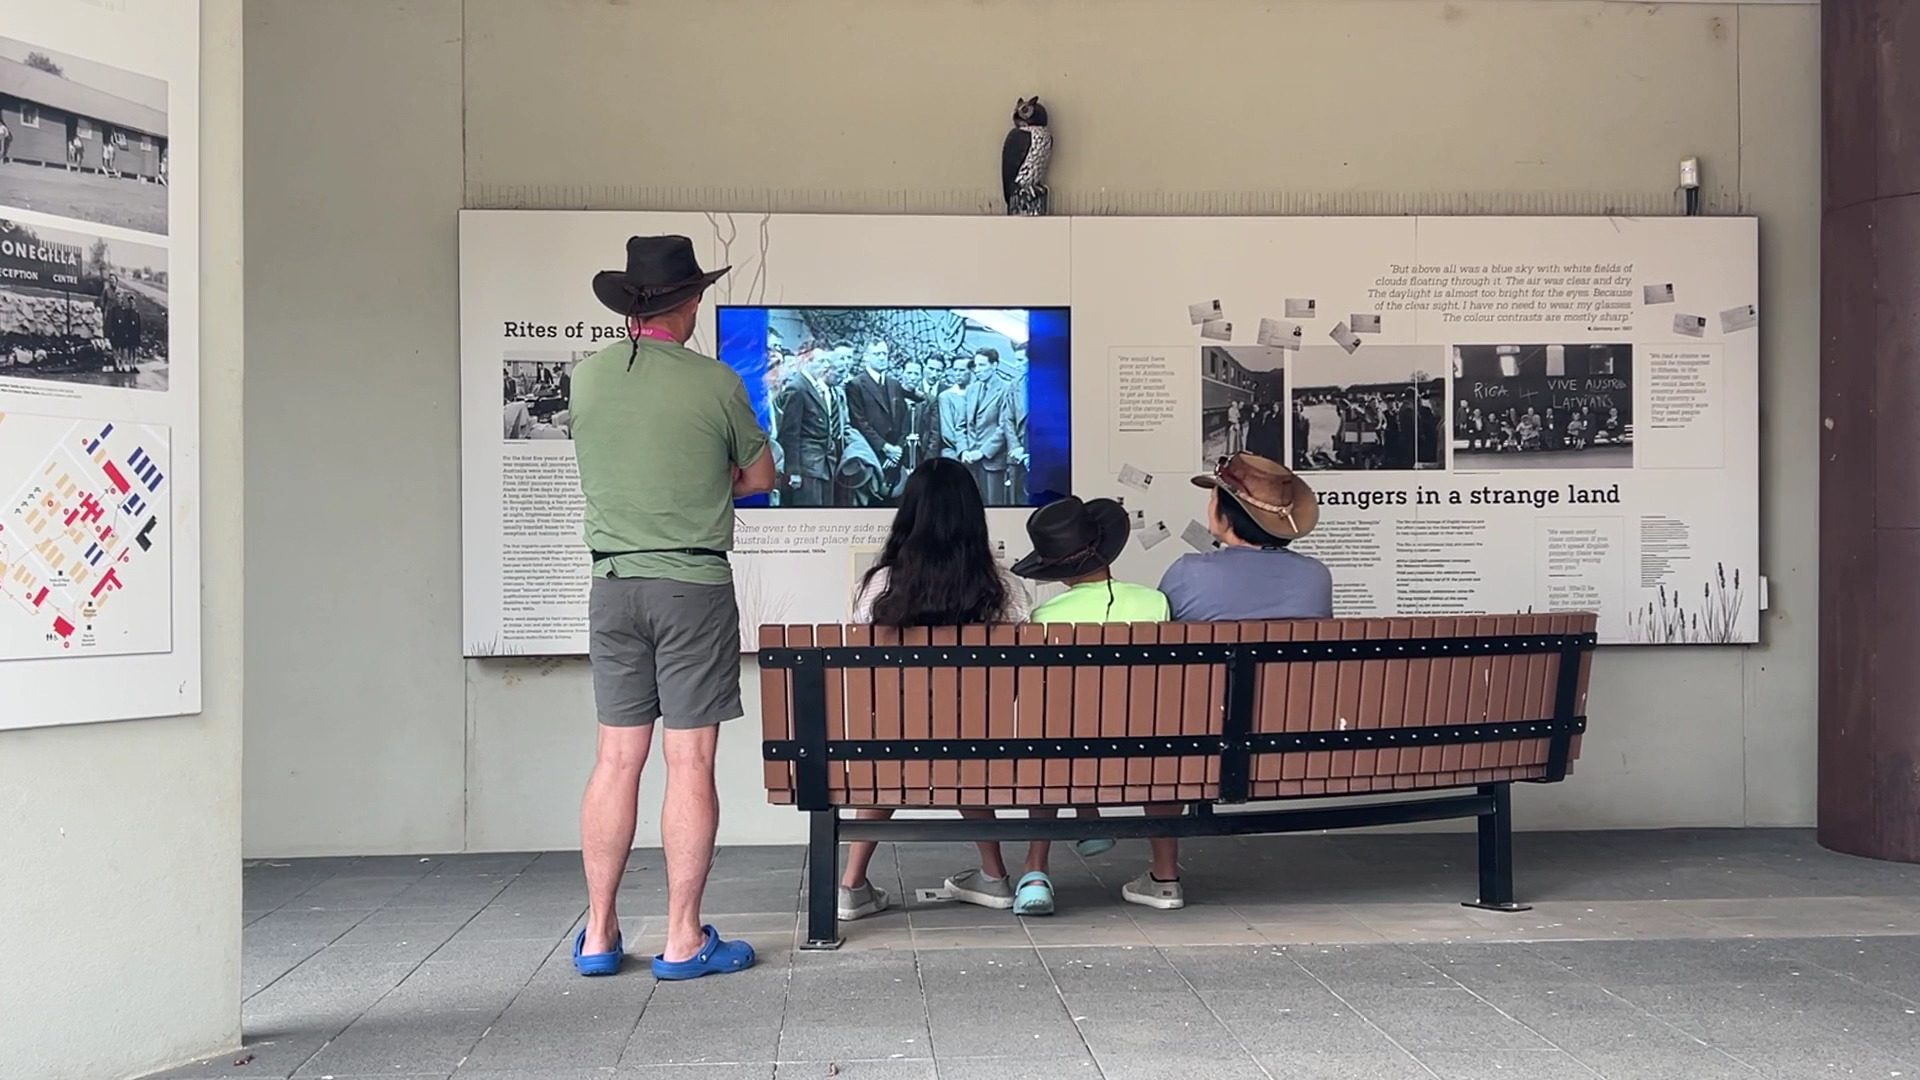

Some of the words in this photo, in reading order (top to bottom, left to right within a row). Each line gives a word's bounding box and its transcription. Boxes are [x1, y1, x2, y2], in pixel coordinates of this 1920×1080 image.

[2, 240, 76, 266] ONEGILLA
[1412, 264, 1441, 274] above
[1444, 264, 1457, 274] all
[1492, 264, 1512, 273] blue
[1515, 264, 1534, 274] sky
[1537, 264, 1560, 273] with
[1563, 264, 1591, 273] white
[1594, 264, 1621, 273] fields
[1624, 264, 1633, 273] of
[53, 274, 78, 284] CENTRE
[1376, 276, 1407, 286] clouds
[1410, 276, 1448, 287] floating
[1451, 276, 1490, 287] through
[1506, 276, 1524, 286] The
[1527, 277, 1541, 285] air
[1566, 276, 1591, 285] clear
[1593, 276, 1612, 285] and
[1368, 288, 1386, 298] The
[1389, 288, 1430, 299] daylight
[1434, 290, 1442, 298] is
[1445, 288, 1478, 298] almost
[1481, 289, 1496, 298] too
[1499, 288, 1529, 299] bright
[1531, 288, 1545, 298] for
[1548, 288, 1564, 297] the
[1593, 288, 1633, 297] Because
[1374, 301, 1384, 311] of
[1387, 301, 1402, 310] the
[1405, 301, 1430, 310] clear
[1462, 301, 1467, 310] I
[1469, 301, 1494, 310] have
[1511, 301, 1534, 310] need
[1538, 301, 1546, 310] to
[1576, 302, 1592, 311] my
[1442, 312, 1462, 322] The
[1464, 312, 1494, 322] colour
[1497, 313, 1543, 322] contrasts
[1563, 312, 1598, 323] mostly
[504, 322, 557, 338] Rites
[565, 322, 584, 338] of
[591, 322, 628, 342] pas
[1547, 379, 1577, 390] VIVE
[1312, 490, 1407, 510] rangers
[1416, 485, 1440, 505] in
[1448, 490, 1462, 505] a
[1470, 486, 1560, 509] strange
[1567, 484, 1620, 504] land
[788, 524, 796, 533] to
[800, 523, 816, 533] the
[818, 525, 851, 534] sunny
[853, 523, 874, 532] side
[734, 535, 780, 546] Australia
[793, 535, 819, 546] great
[822, 535, 848, 546] place
[851, 535, 864, 546] for
